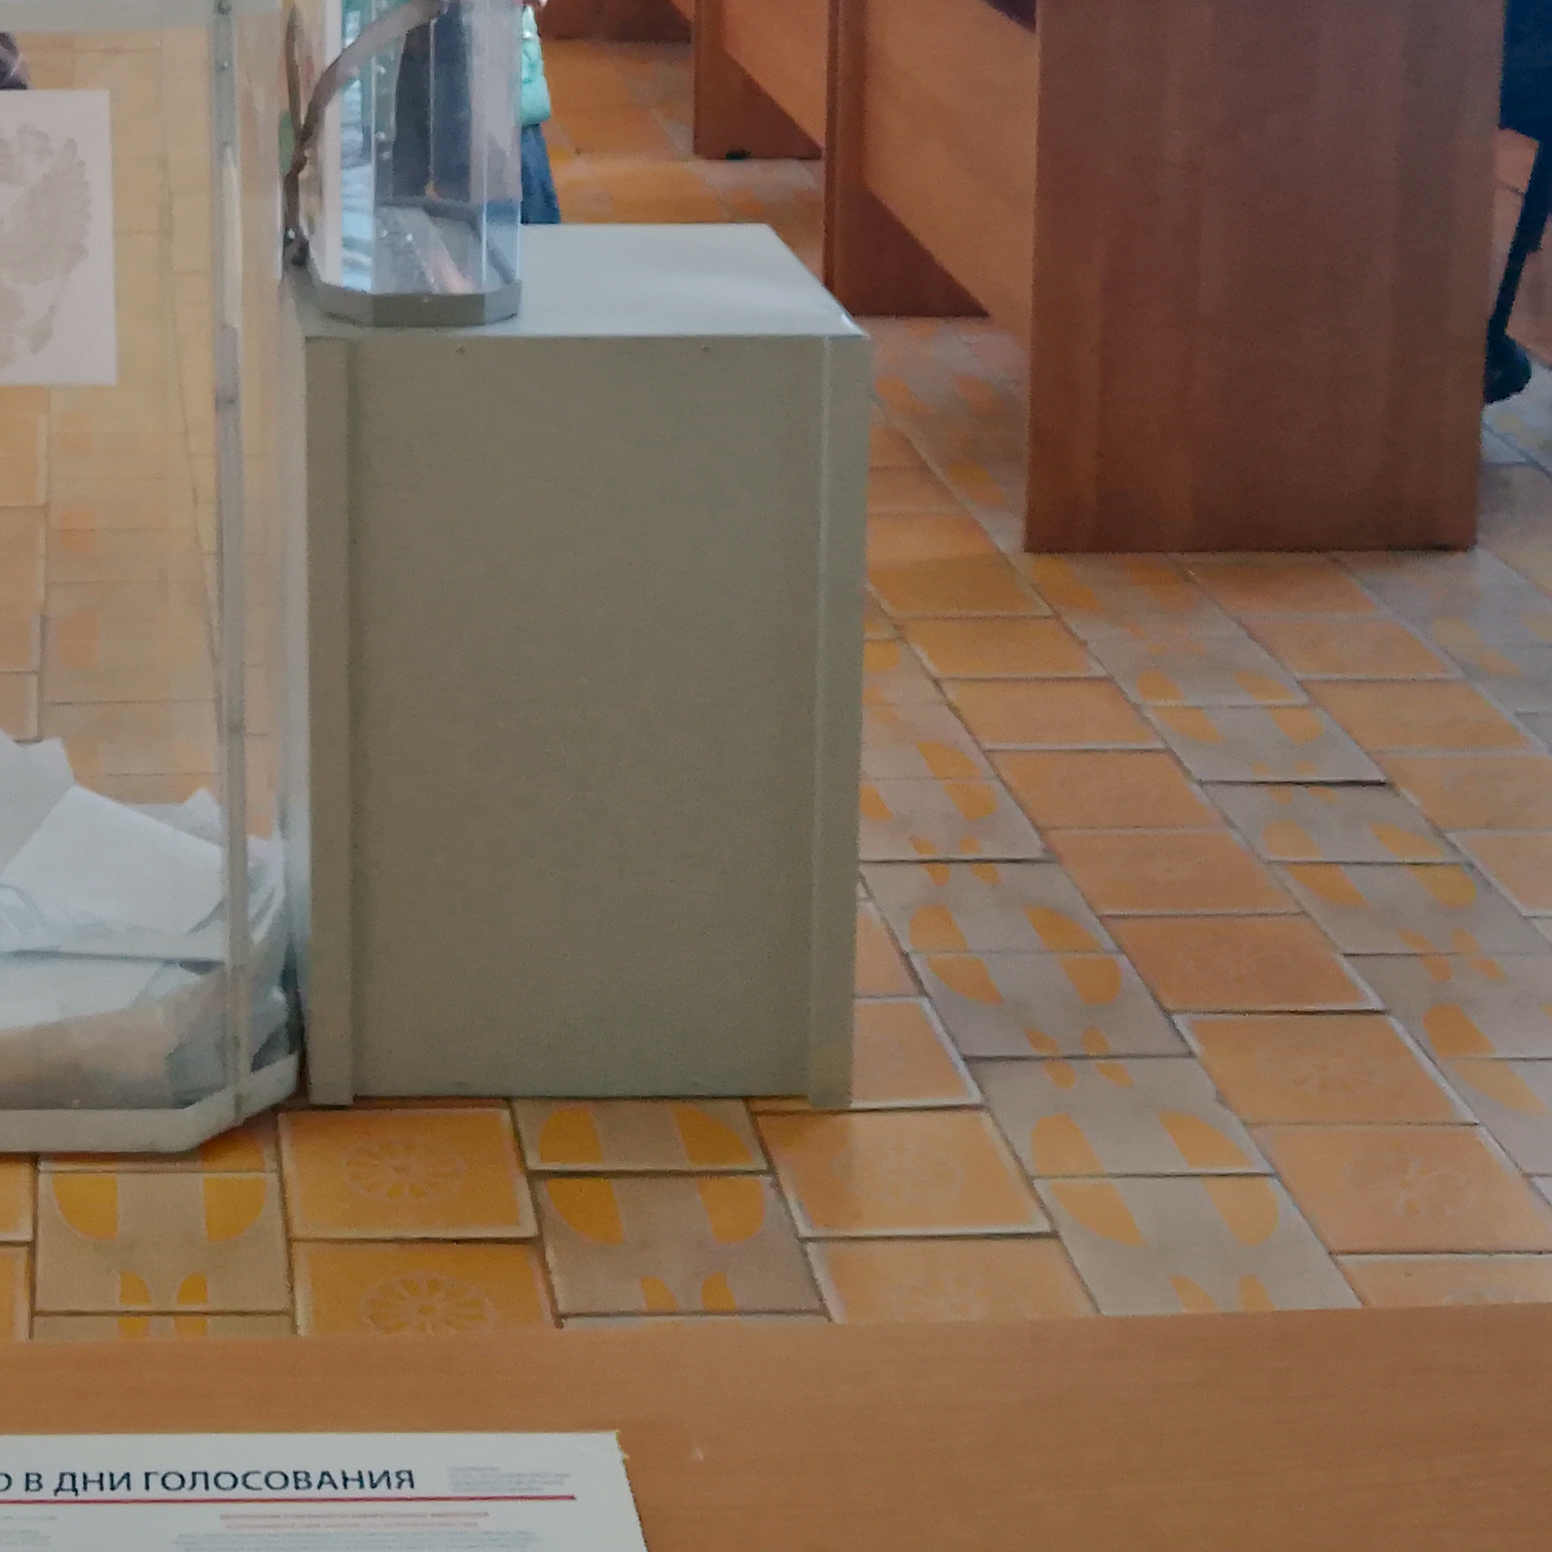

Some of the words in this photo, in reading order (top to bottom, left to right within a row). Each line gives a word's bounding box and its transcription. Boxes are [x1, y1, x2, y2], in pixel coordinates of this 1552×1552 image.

[24, 1471, 43, 1492] В
[53, 1471, 132, 1497] ДНИ
[143, 1469, 415, 1492] ГОЛОСОВАНИЯ
